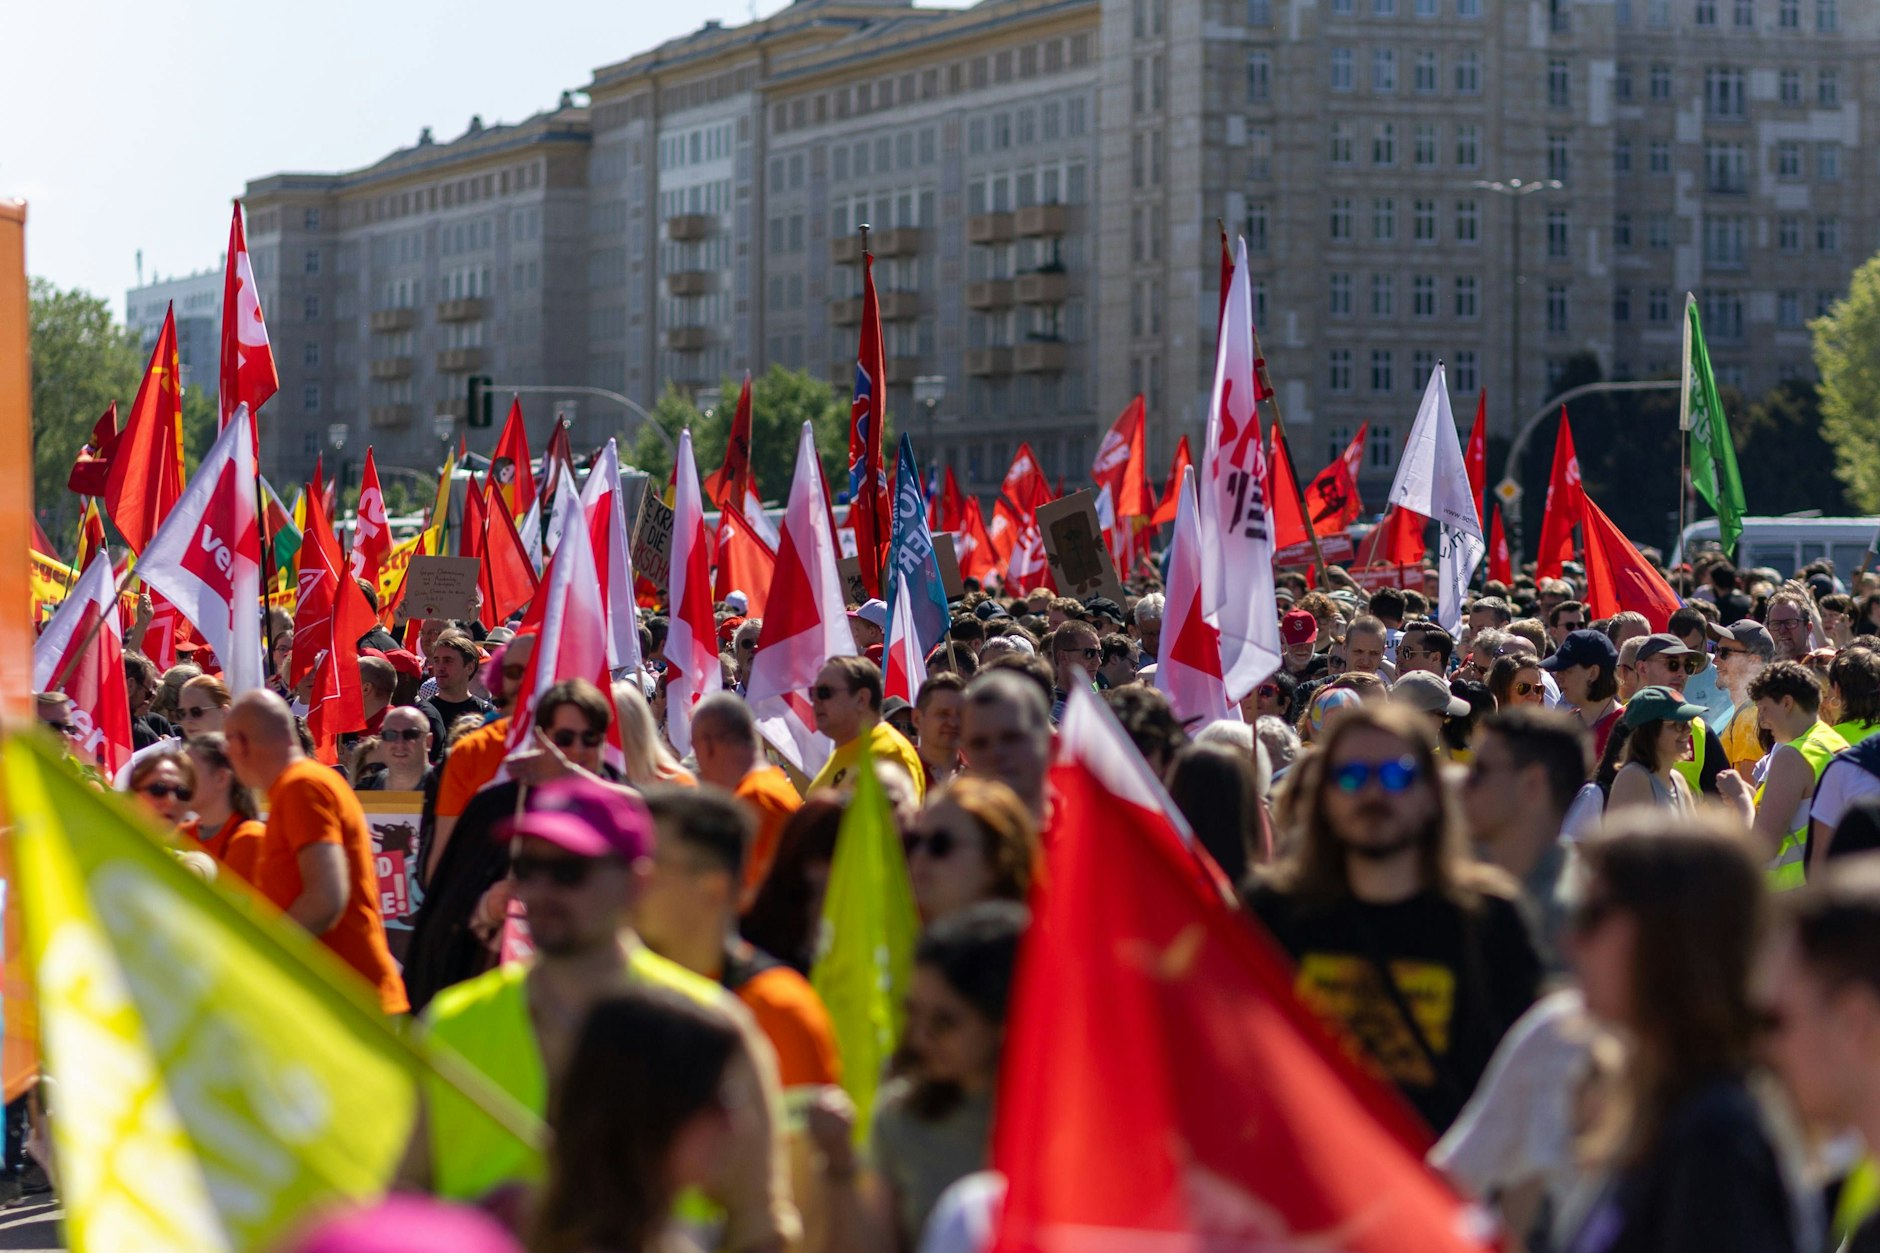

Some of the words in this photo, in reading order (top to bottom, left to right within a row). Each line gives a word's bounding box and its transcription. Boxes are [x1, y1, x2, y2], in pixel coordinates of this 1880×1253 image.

[647, 525, 668, 553] DIE
[376, 856, 393, 878] D
[380, 873, 407, 915] E!
